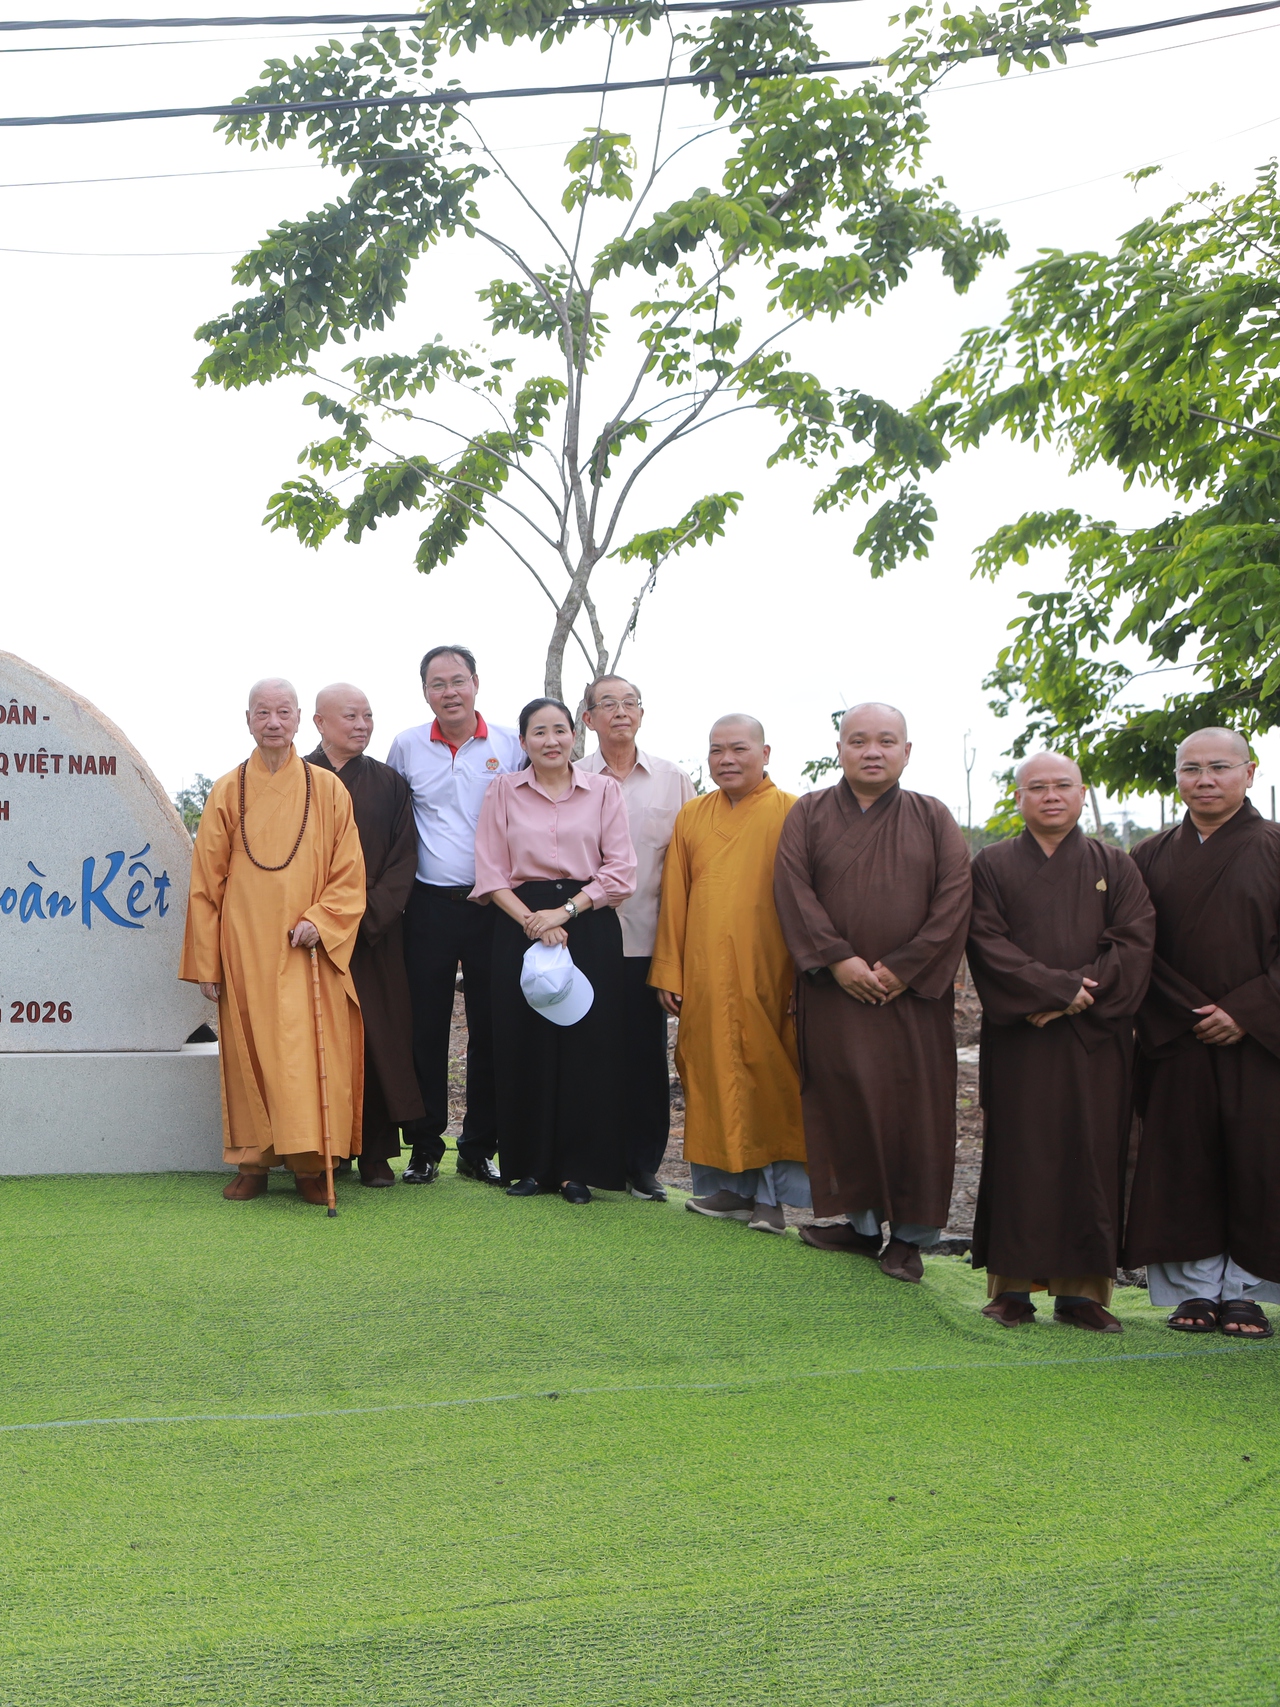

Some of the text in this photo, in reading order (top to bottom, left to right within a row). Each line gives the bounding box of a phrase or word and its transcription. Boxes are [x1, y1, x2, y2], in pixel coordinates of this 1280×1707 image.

[13, 747, 64, 779] VIỆT
[68, 754, 117, 776] NAM
[81, 843, 171, 930] Kết
[10, 1001, 72, 1023] 2026
